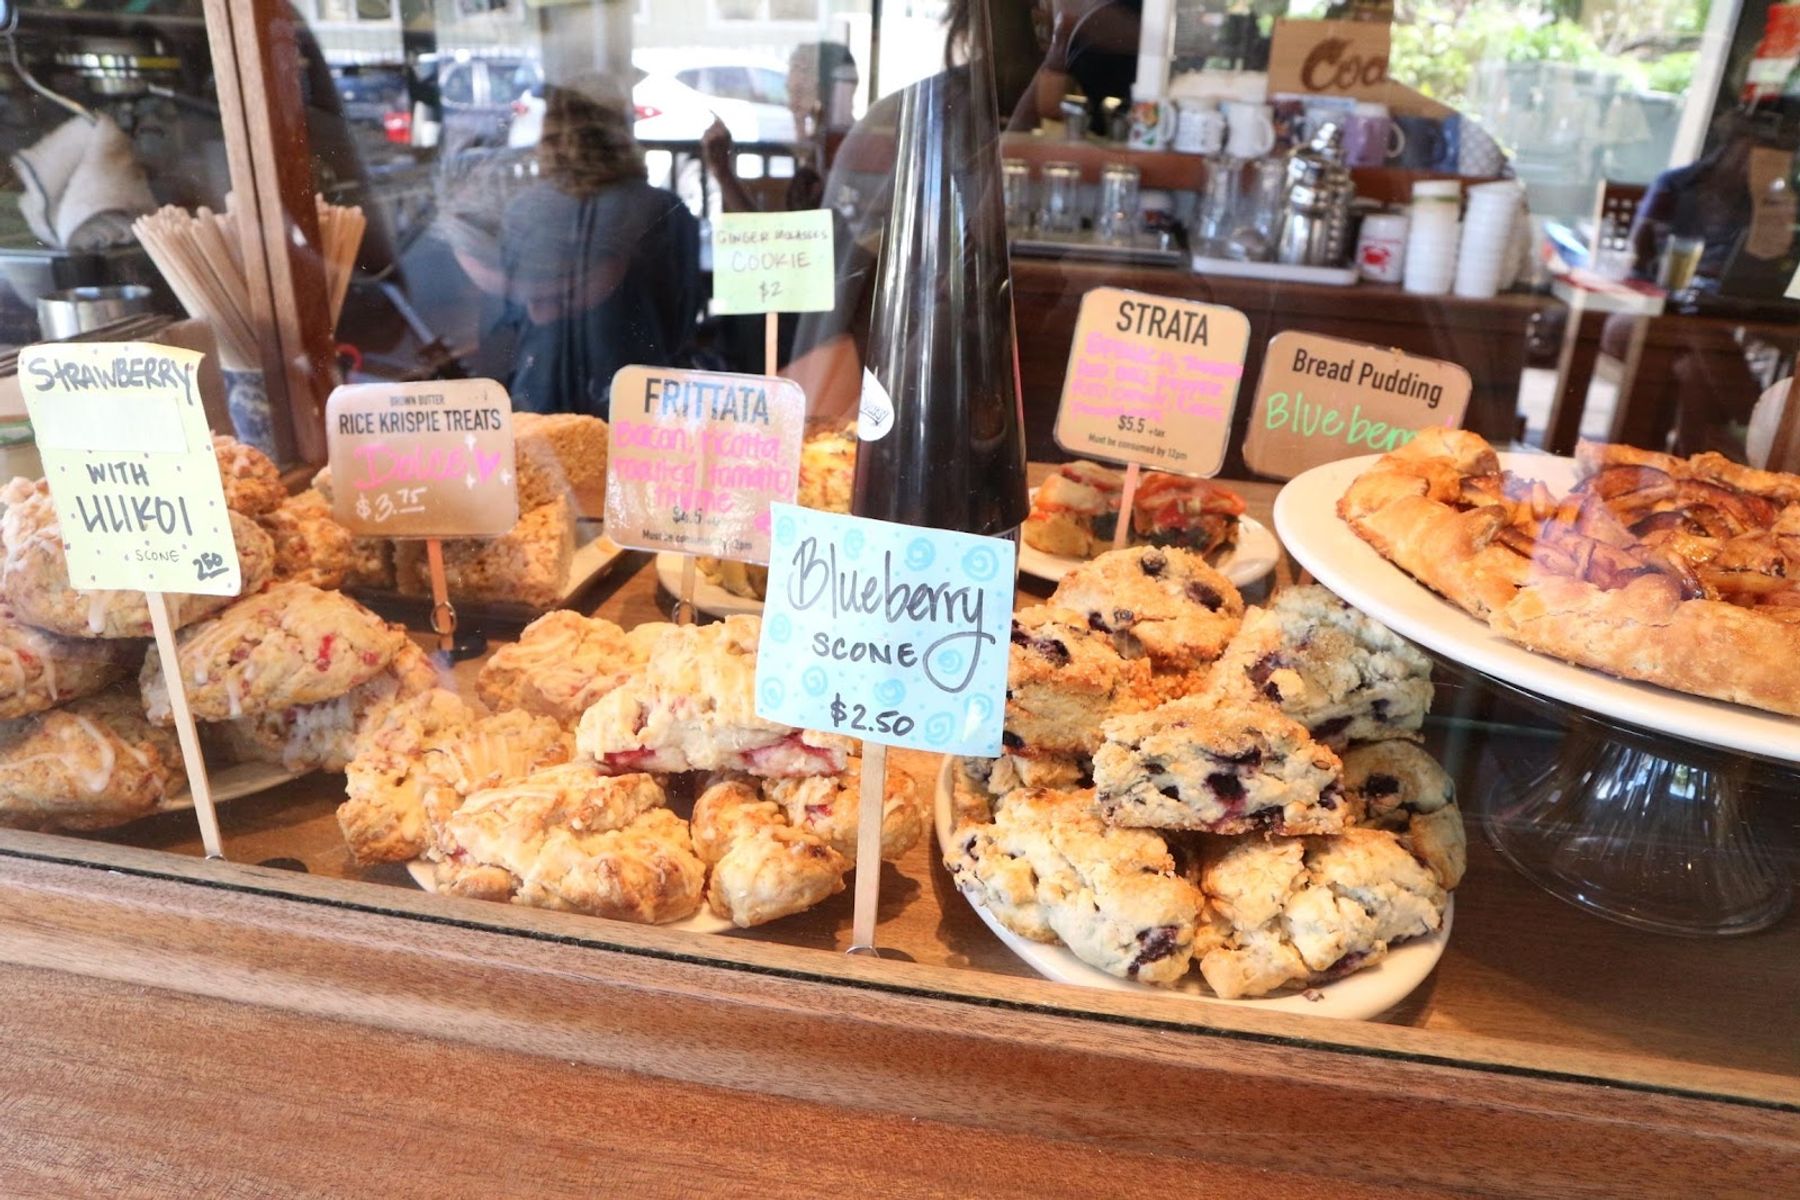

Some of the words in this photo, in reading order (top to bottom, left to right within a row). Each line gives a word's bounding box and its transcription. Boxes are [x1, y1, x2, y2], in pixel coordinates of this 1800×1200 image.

[731, 251, 811, 273] COOKIE
[759, 280, 784, 304] $2
[1116, 300, 1209, 347] STRATA
[1292, 348, 1354, 383] Bread
[1357, 362, 1444, 409] Pudding
[644, 378, 770, 426] FRITTATA
[339, 413, 375, 434] RICE
[379, 411, 441, 434] KRISPIE
[444, 408, 502, 432] TREATS
[1118, 414, 1146, 434] $5.5
[1088, 431, 1106, 445] Must
[86, 461, 150, 487] WITH
[135, 549, 180, 563] SCONE
[787, 536, 997, 694] Blueberry
[812, 632, 918, 668] SCONE
[830, 692, 915, 737] $2.50
